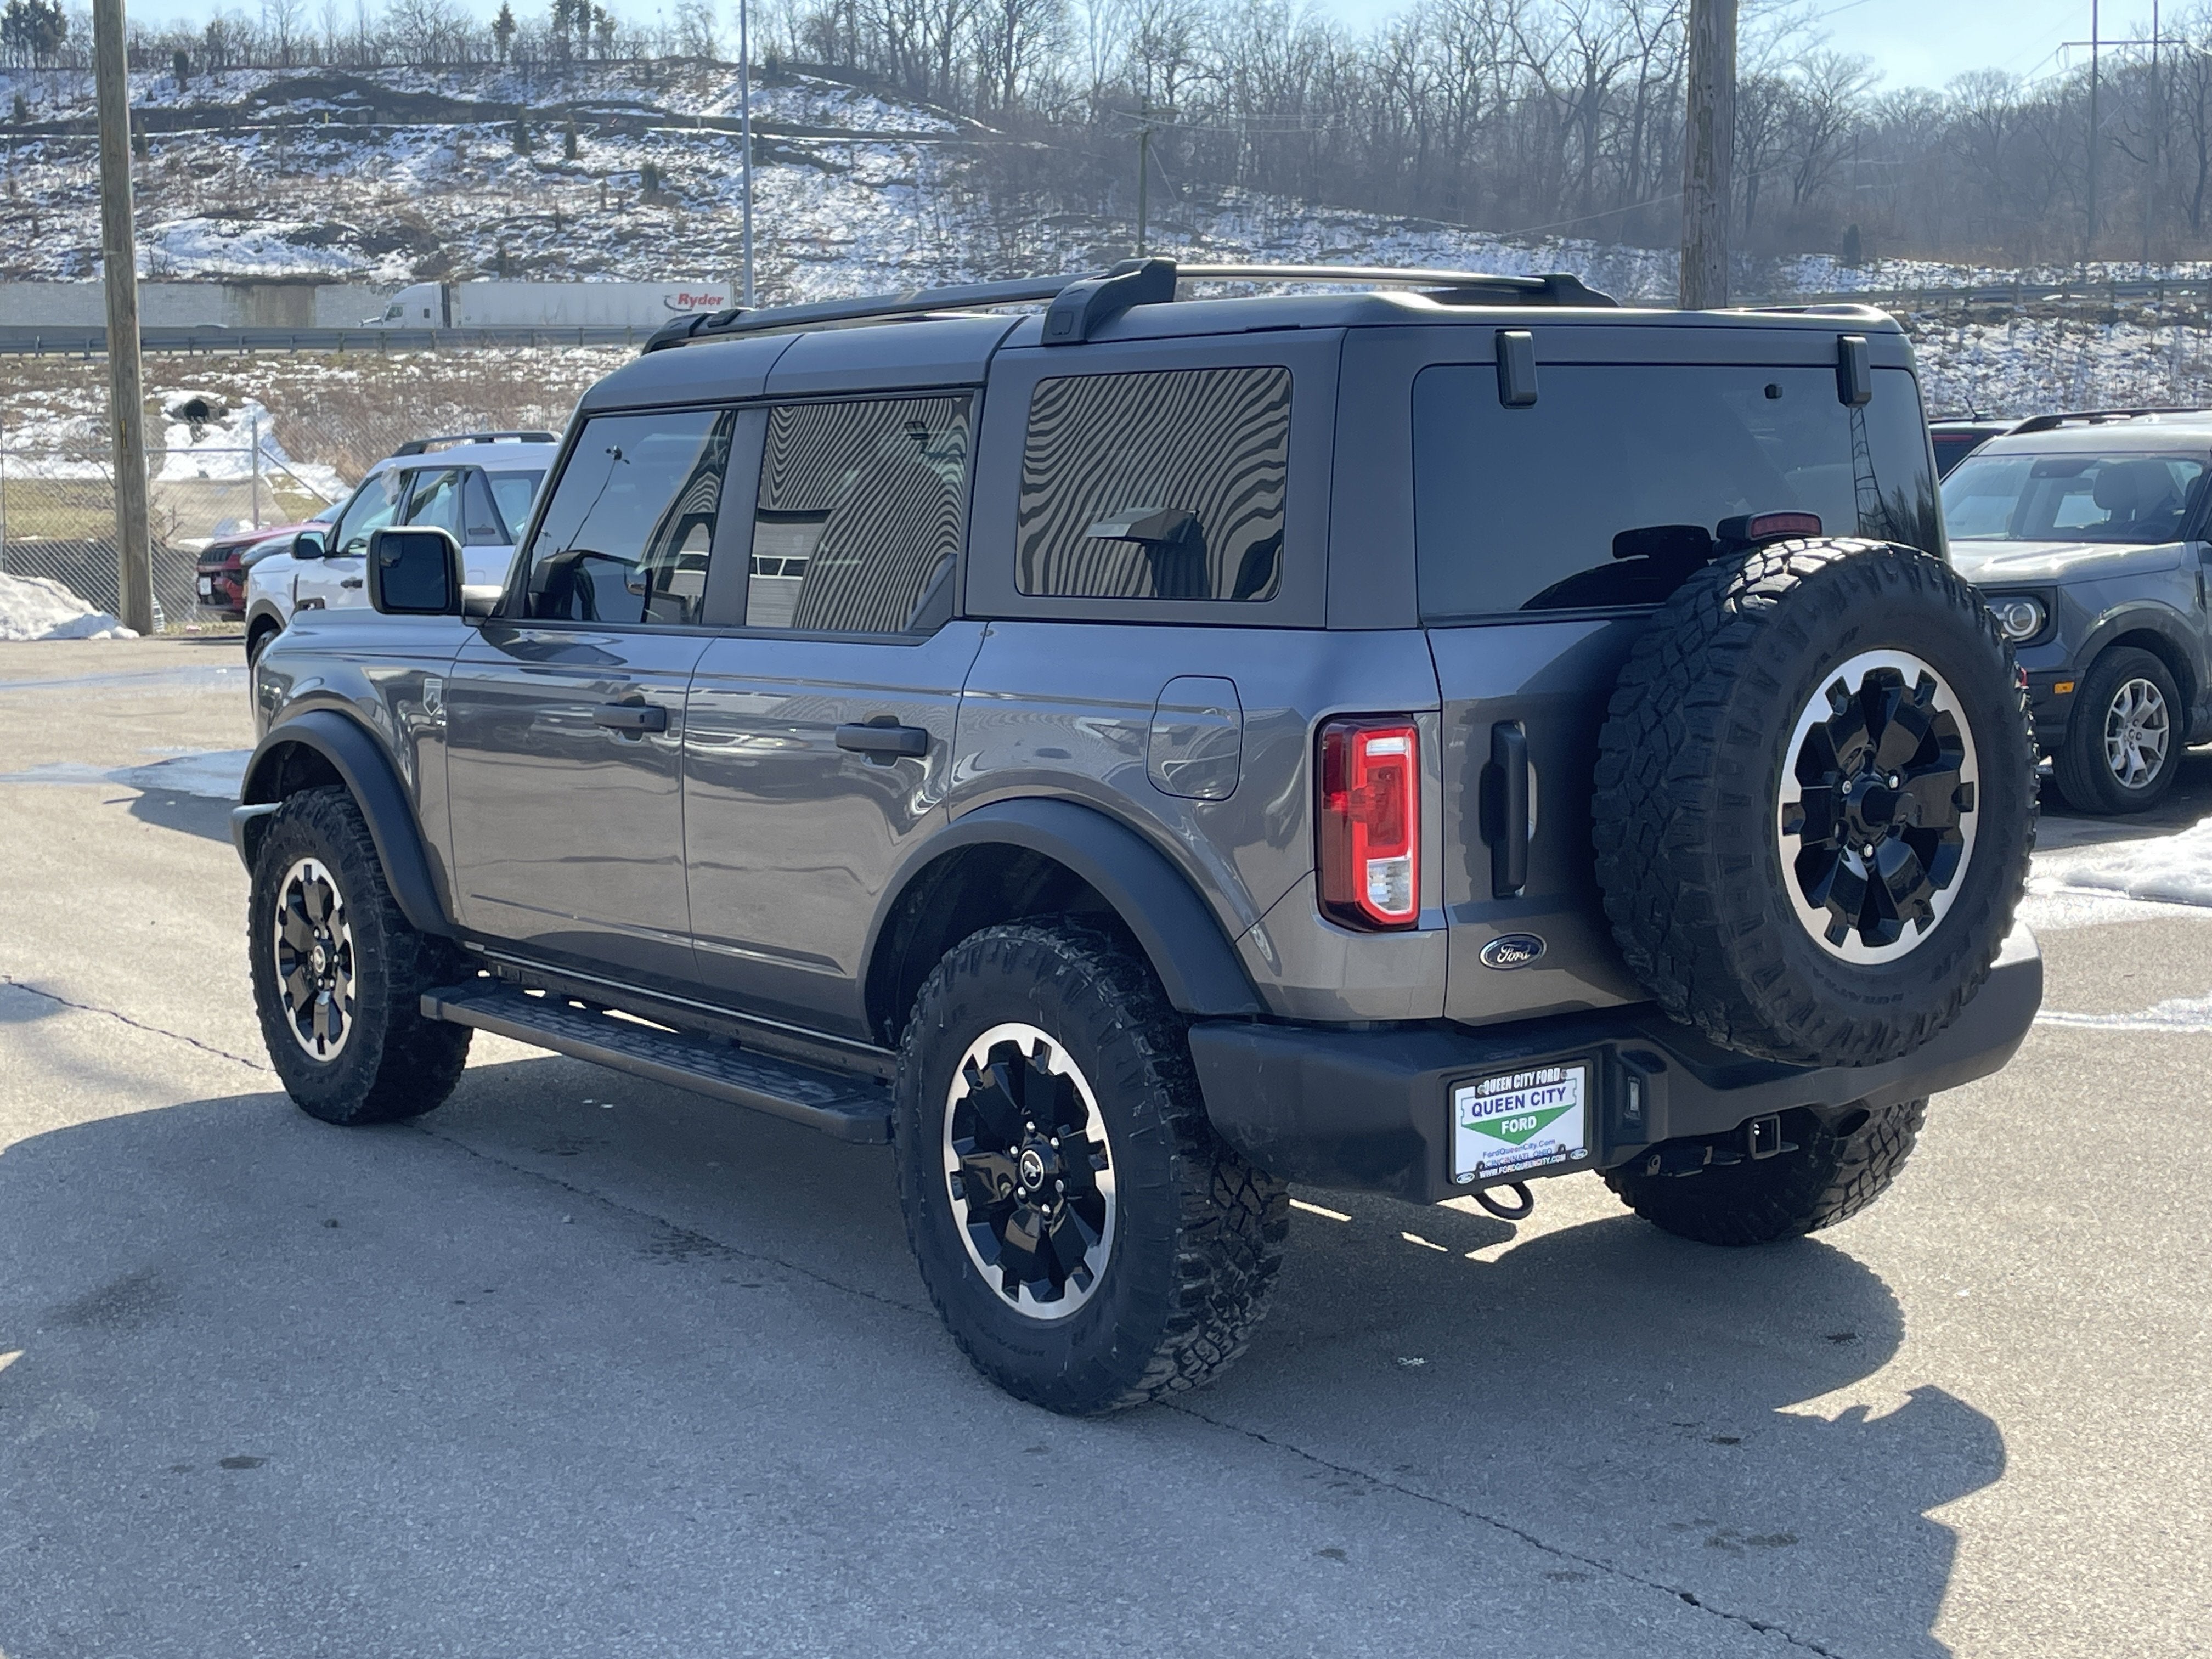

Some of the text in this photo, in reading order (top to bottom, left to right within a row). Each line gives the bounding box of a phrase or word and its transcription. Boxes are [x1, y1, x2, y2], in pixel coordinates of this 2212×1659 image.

[678, 293, 724, 307] Ryder
[1497, 944, 1531, 963] Ford
[1483, 1068, 1560, 1095] QUEEN CITY FORD
[1472, 1086, 1566, 1117] QUEEN CITY
[1502, 1116, 1537, 1135] FORD
